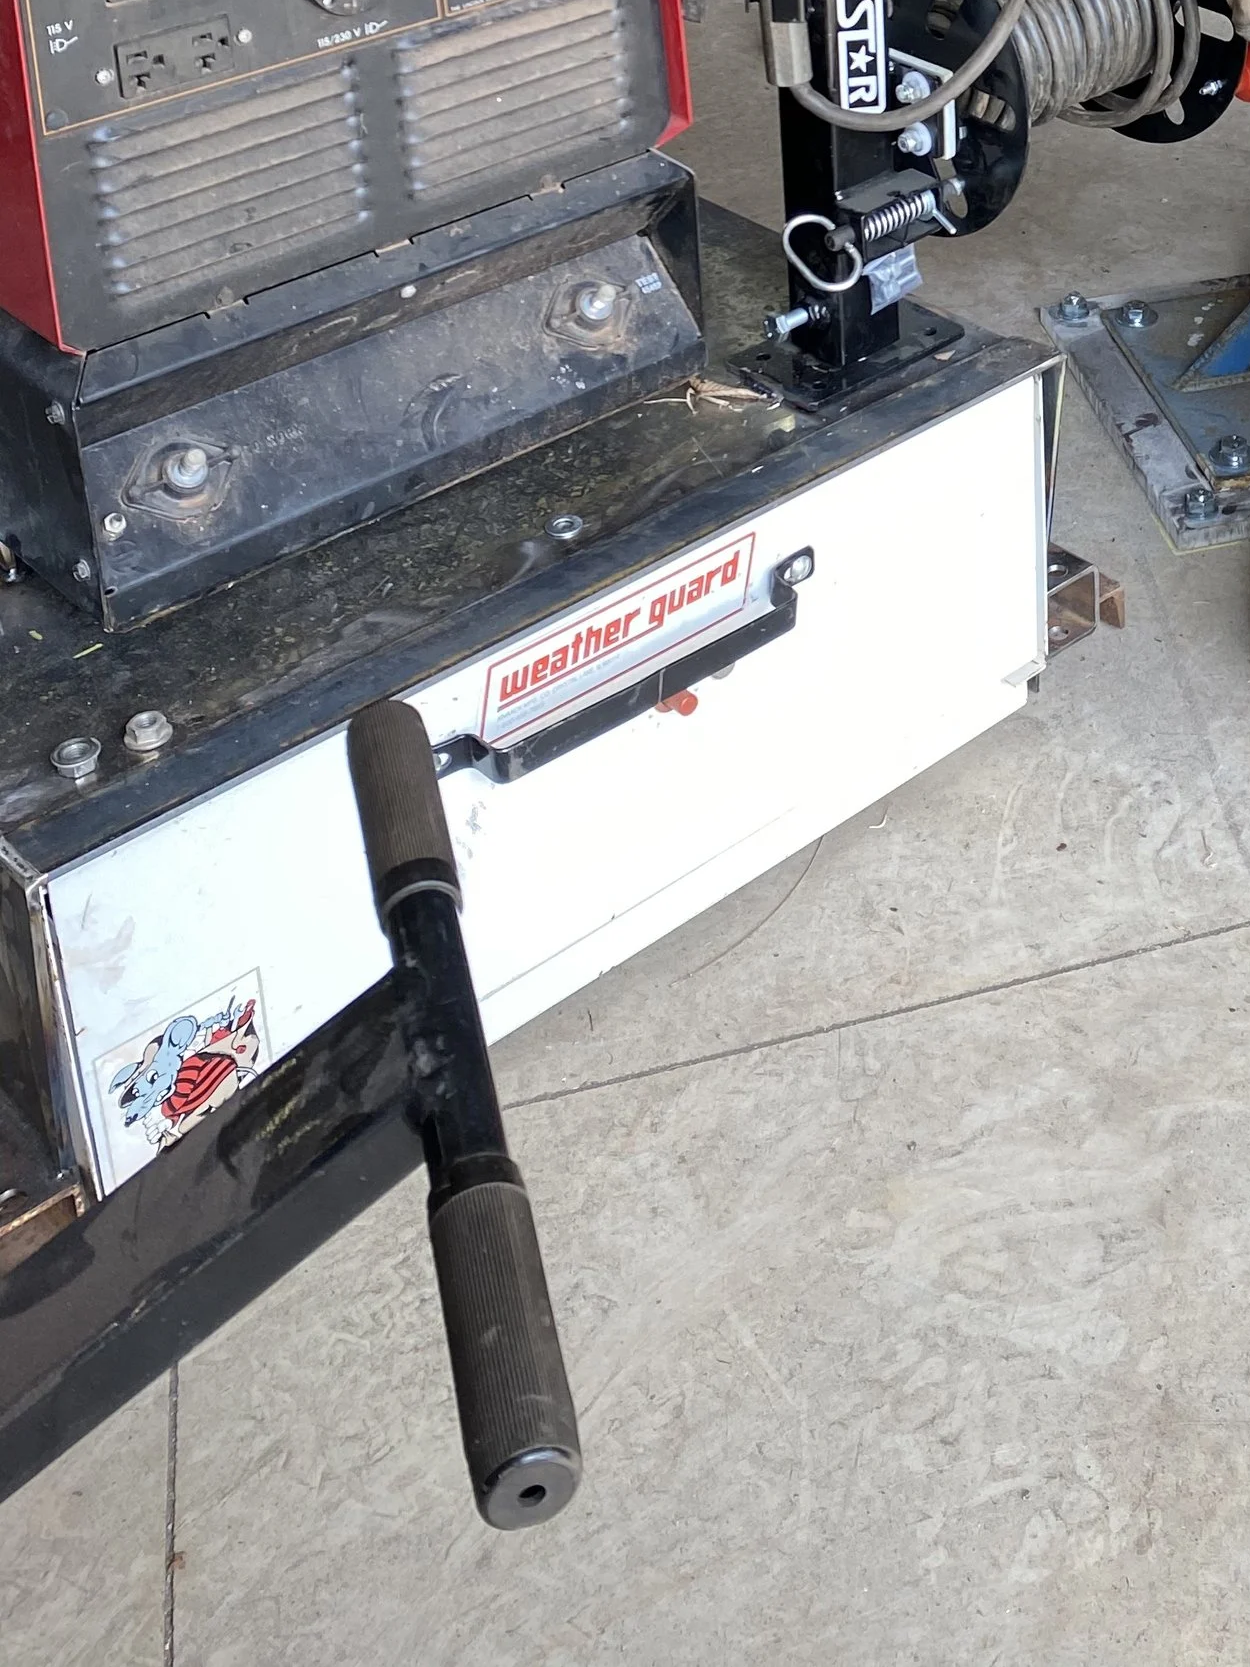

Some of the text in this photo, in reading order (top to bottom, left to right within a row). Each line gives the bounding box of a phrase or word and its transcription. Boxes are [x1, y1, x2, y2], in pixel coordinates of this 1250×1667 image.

[46, 20, 73, 37] 115 V
[317, 26, 361, 48] 115/230 V
[499, 549, 741, 703] weather guard
